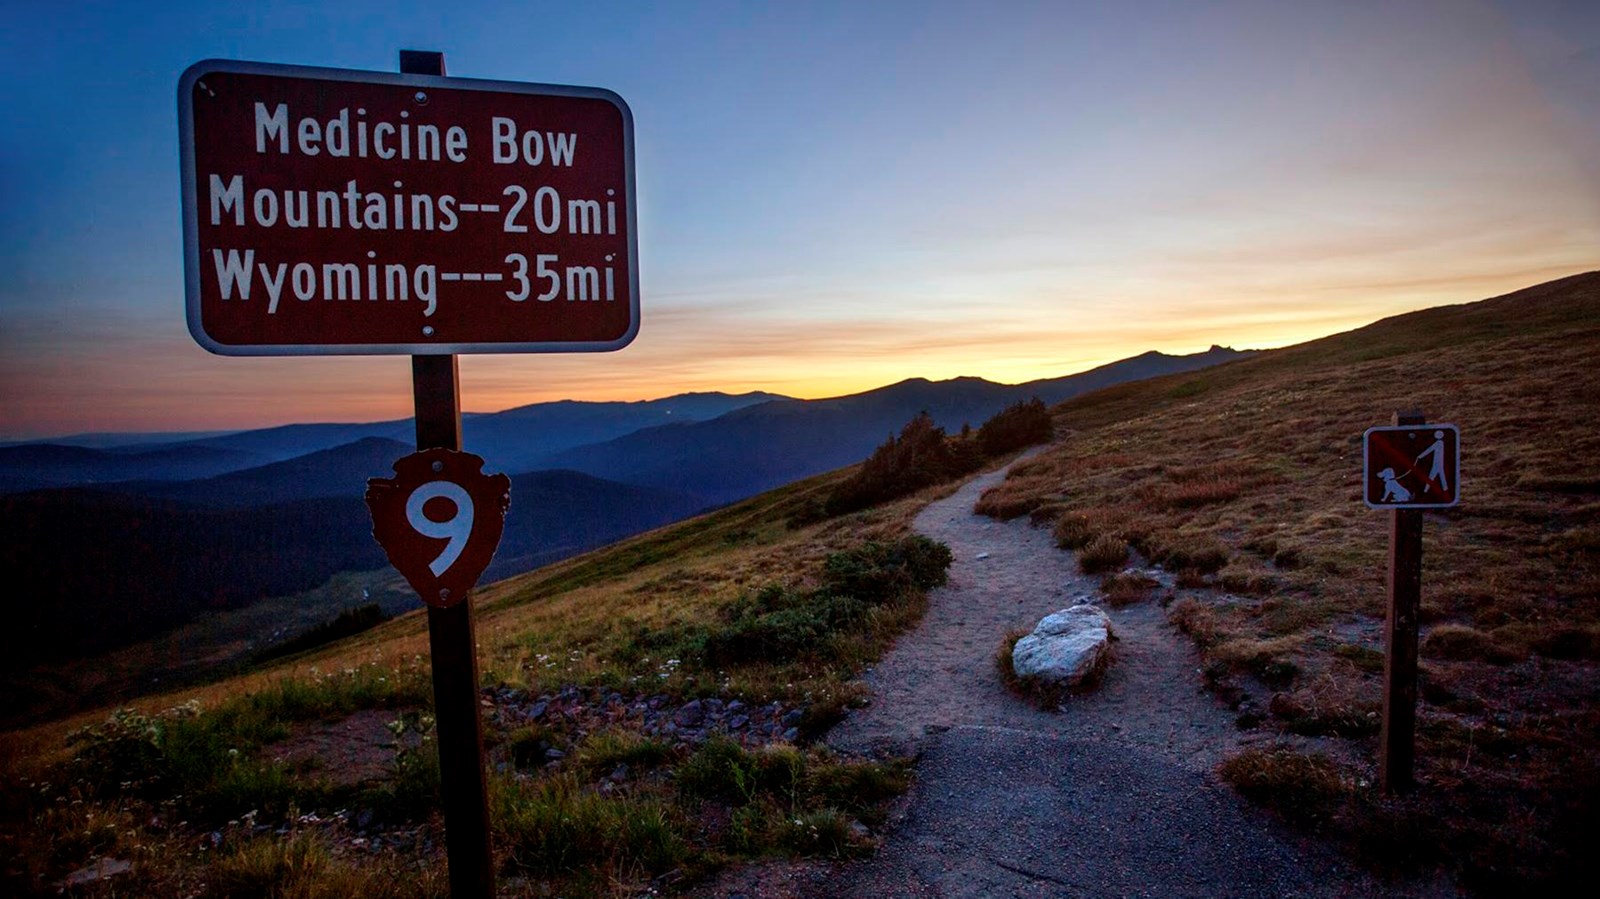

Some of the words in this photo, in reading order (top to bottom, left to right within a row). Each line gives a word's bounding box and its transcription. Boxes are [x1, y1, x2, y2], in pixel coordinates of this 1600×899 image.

[254, 102, 468, 163] Medicine
[491, 116, 577, 168] Bow
[405, 480, 475, 578] 9
